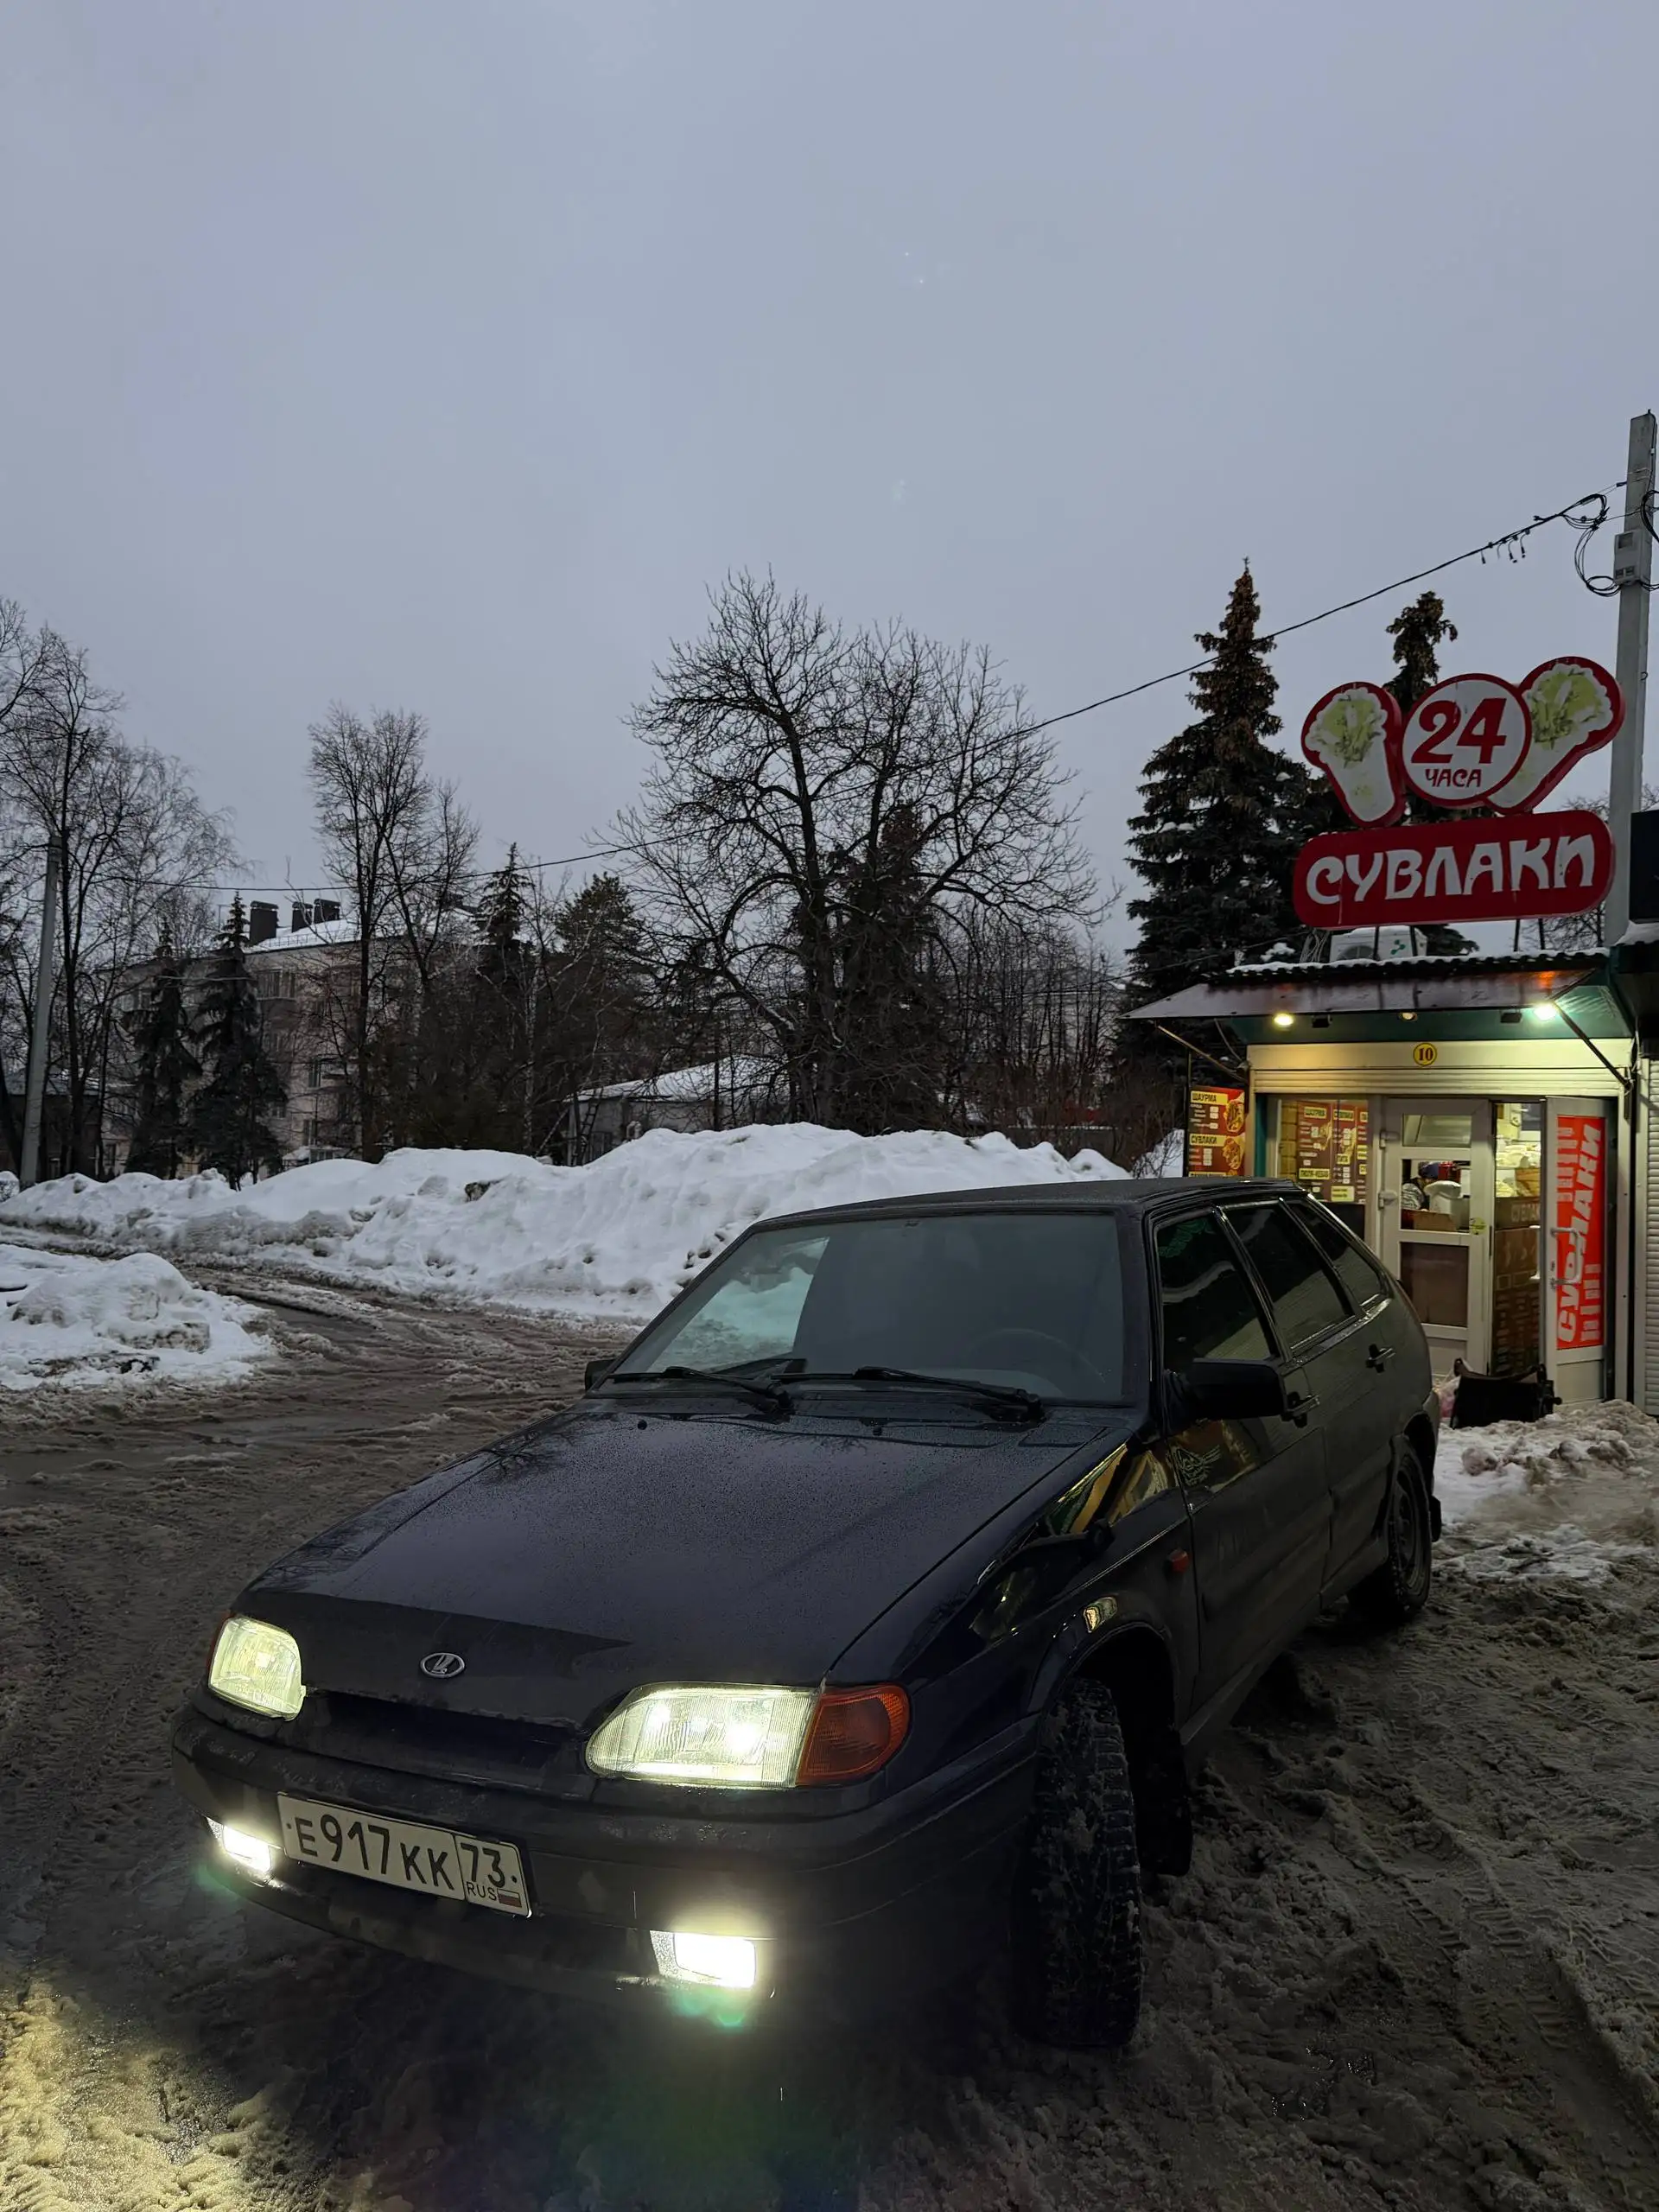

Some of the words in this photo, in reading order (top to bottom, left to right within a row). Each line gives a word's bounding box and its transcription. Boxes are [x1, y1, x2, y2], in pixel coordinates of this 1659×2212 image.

[1411, 697, 1507, 764] 24
[1424, 768, 1483, 788] ЧАСА
[1306, 834, 1596, 906] СУВЛАКИ
[1419, 1047, 1434, 1061] 10
[1192, 1092, 1217, 1103] ШАУРМА
[294, 1814, 454, 1891] Е917КК
[460, 1841, 506, 1889] 73
[466, 1881, 498, 1902] RUS
